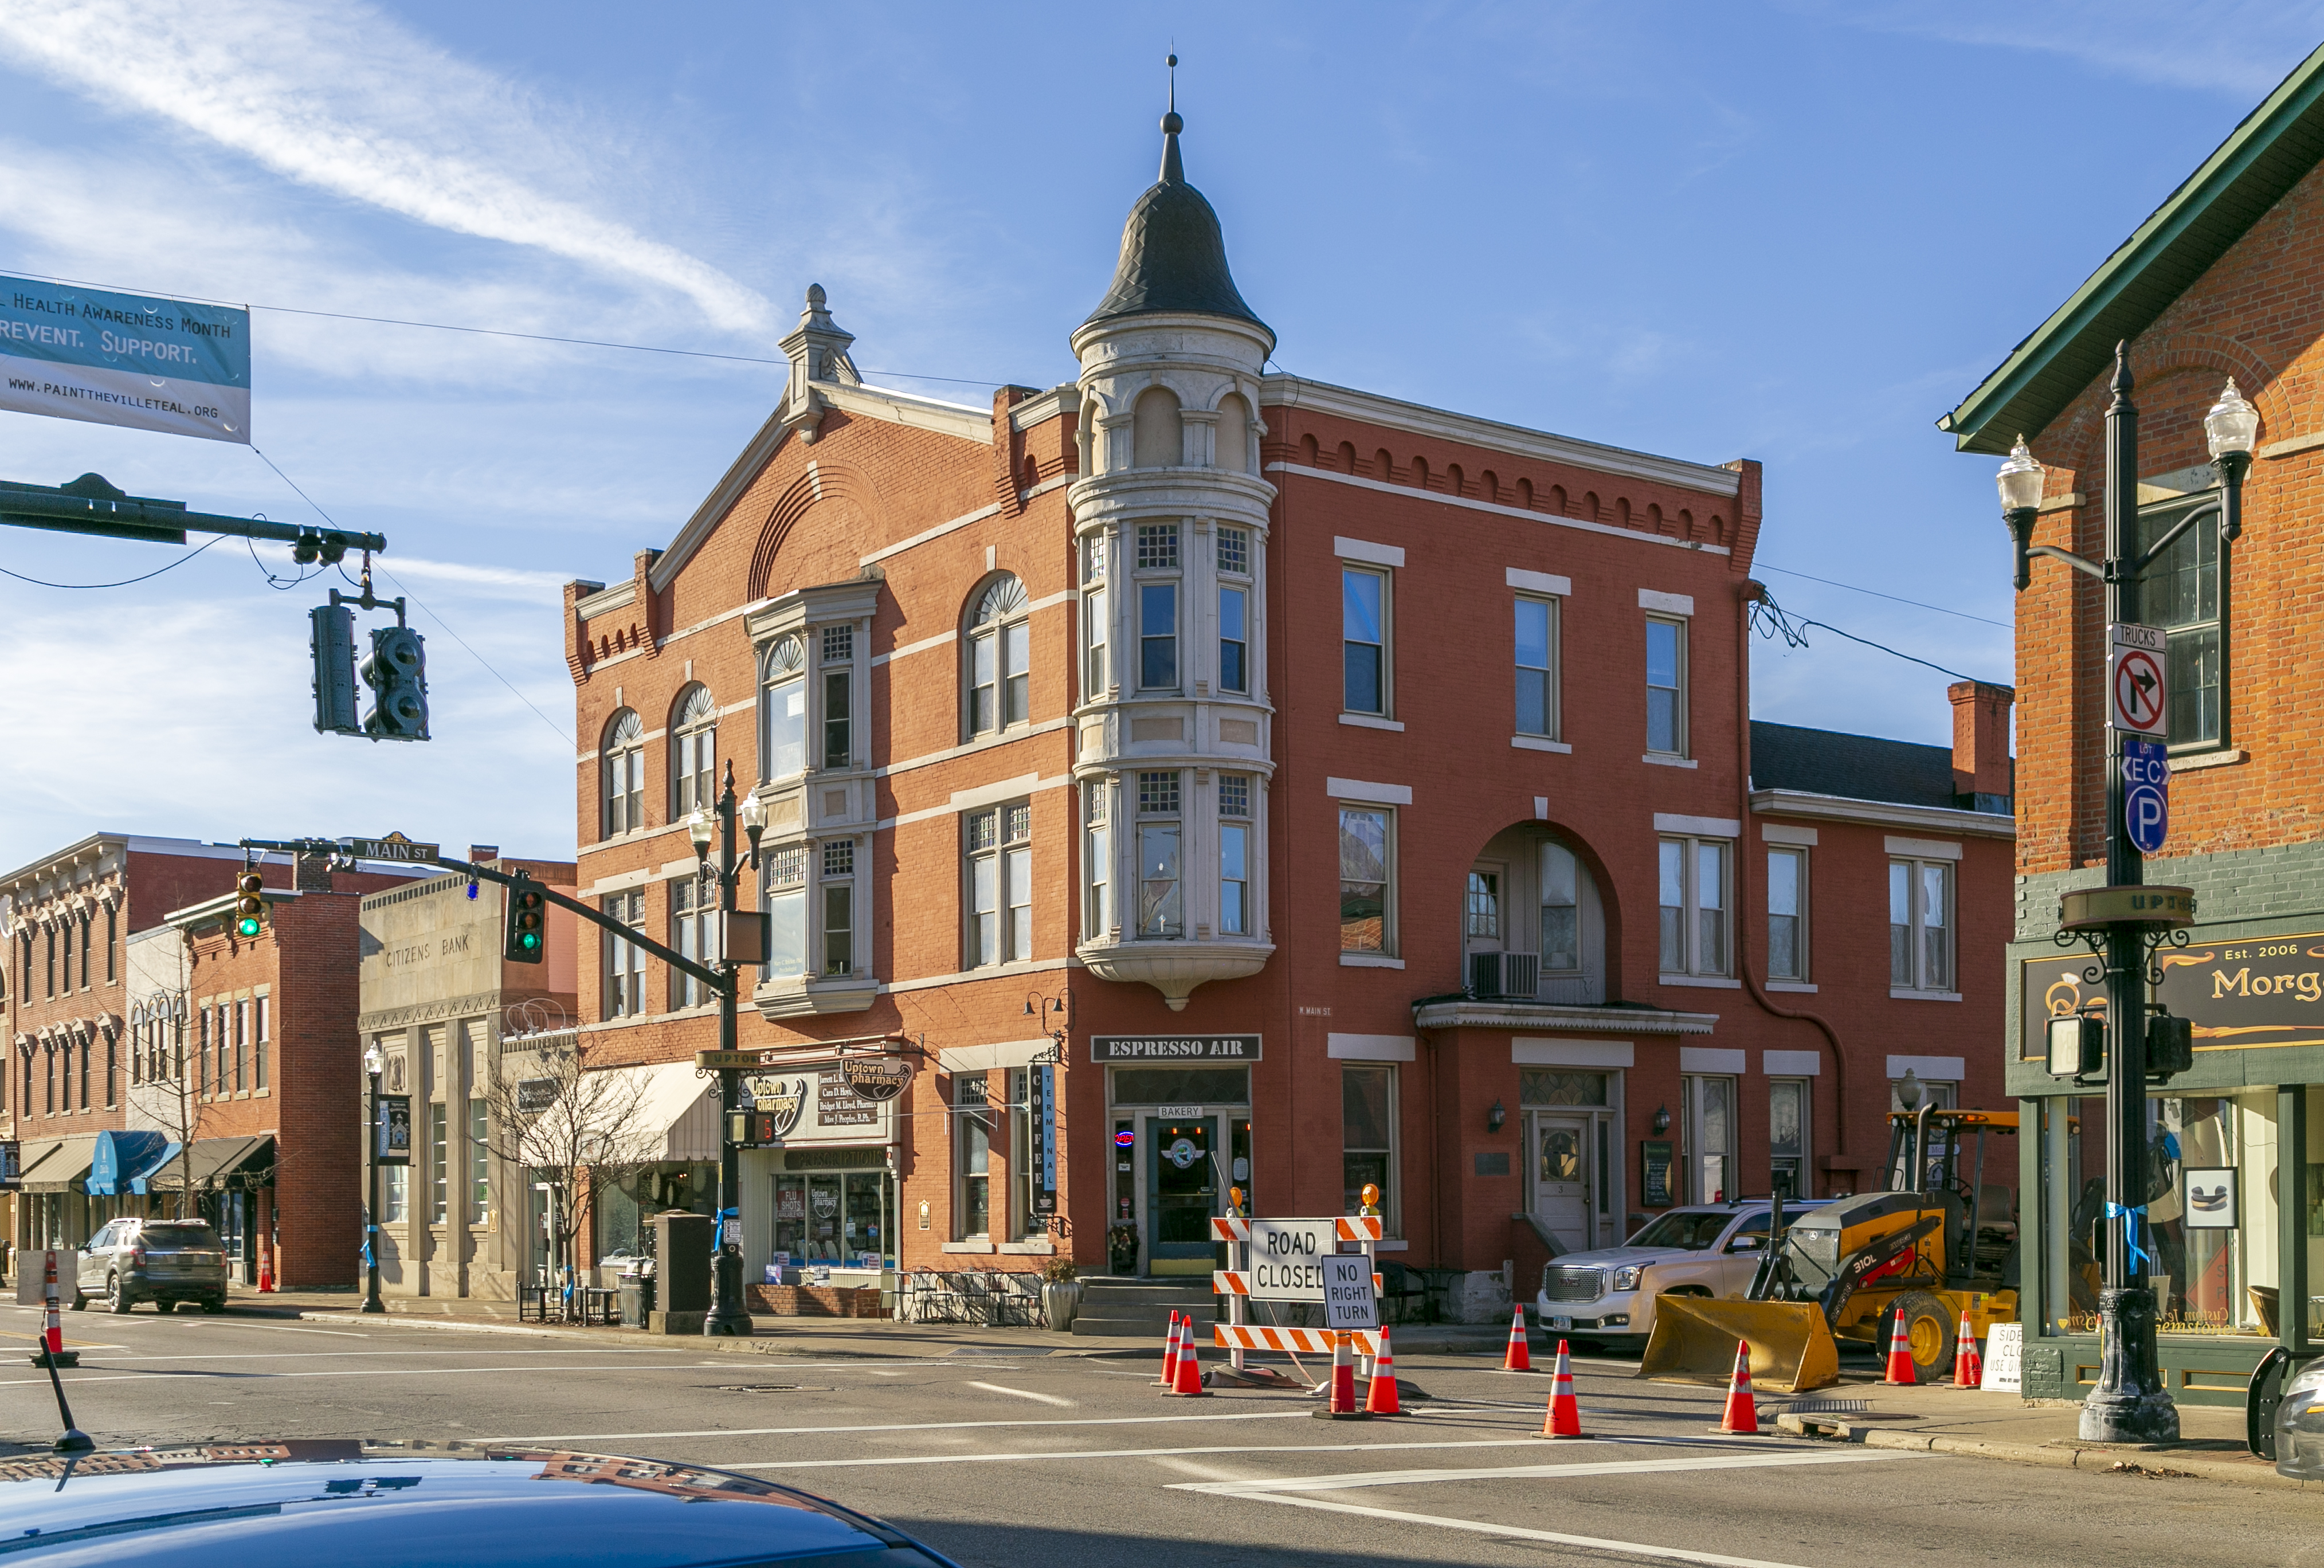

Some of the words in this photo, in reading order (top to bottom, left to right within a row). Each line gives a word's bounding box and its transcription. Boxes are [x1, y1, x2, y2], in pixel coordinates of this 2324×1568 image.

[2120, 625, 2156, 647] TRUCKS
[2139, 744, 2153, 754] LOT
[2138, 797, 2161, 842] P
[365, 842, 410, 860] MAIN
[414, 848, 428, 859] ST
[2132, 895, 2197, 914] UPTO
[386, 943, 430, 967] CITIZENS
[442, 934, 469, 956] BANK
[2224, 949, 2252, 961] Est.
[2259, 944, 2298, 958] 2006
[2212, 967, 2324, 1002] Morg
[1306, 1006, 1321, 1015] MAIN
[1109, 1040, 1204, 1056] ESPRESSO
[1209, 1040, 1244, 1056] AIR
[844, 1061, 884, 1075] Uptown
[753, 1078, 782, 1096] Uptown
[851, 1073, 904, 1087] pharmacy
[822, 1088, 833, 1097] Cara
[833, 1087, 840, 1096] D.
[757, 1096, 798, 1112] pharmacy
[820, 1101, 835, 1111] Bridget
[836, 1100, 842, 1110] M.
[842, 1100, 856, 1110] Lloyd,
[1161, 1107, 1199, 1116] BAKERY
[1032, 1075, 1043, 1184] COFFEE
[1045, 1075, 1053, 1184] TERMINAL
[799, 1150, 883, 1167] PRESCRIPTIONS
[785, 1191, 797, 1201] FLU
[812, 1189, 828, 1198] Uptown
[1558, 1185, 1563, 1194] 3
[781, 1201, 801, 1210] SHOTS
[1267, 1232, 1316, 1256] ROAD
[1853, 1255, 1877, 1273] 310L
[1337, 1264, 1358, 1282] NO
[1331, 1287, 1367, 1301] RIGHT
[1831, 1283, 1852, 1322] 251518
[1335, 1306, 1369, 1320] TURN
[1990, 1359, 2004, 1371] USE
